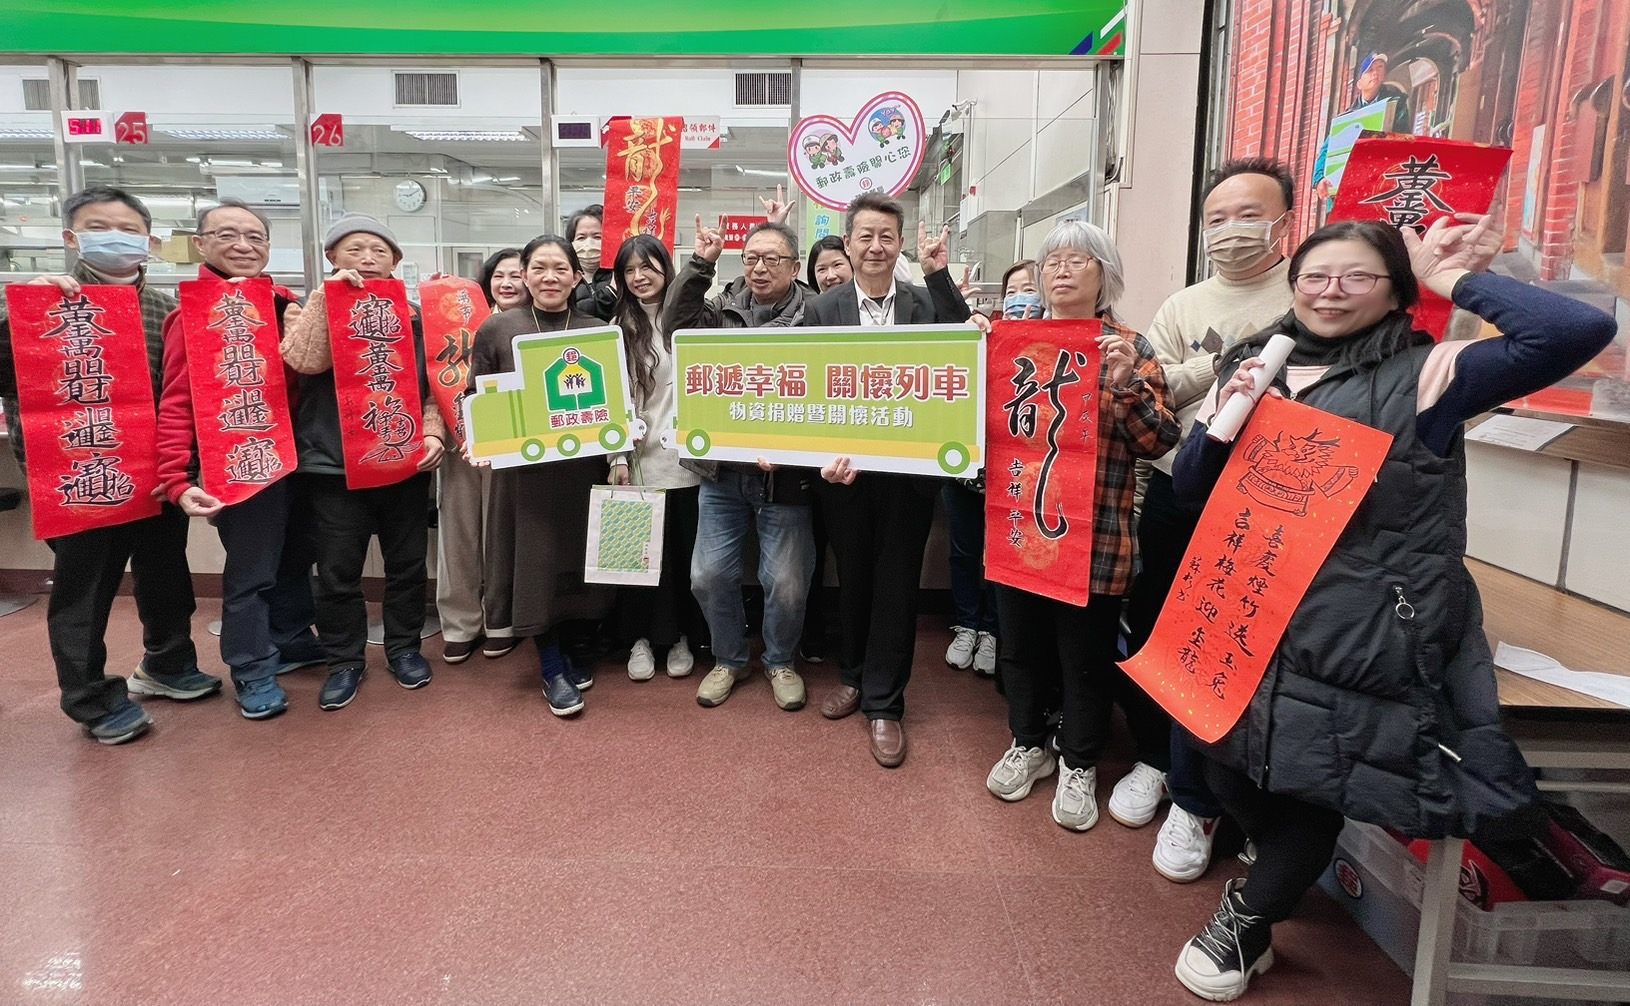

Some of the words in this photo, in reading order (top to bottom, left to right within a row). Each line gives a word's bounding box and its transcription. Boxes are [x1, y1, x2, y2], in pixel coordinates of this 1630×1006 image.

[69, 119, 102, 134] 511
[117, 122, 145, 144] 25
[313, 124, 342, 146] 26
[815, 145, 912, 190] 郵政壽險關心您
[686, 364, 806, 397] 郵遞幸福
[826, 365, 968, 401] 關懷列車
[550, 409, 609, 428] 郵政壽險
[729, 402, 914, 428] 物資捐贈暨關懷活動
[1007, 457, 1026, 548] 吉祥平安
